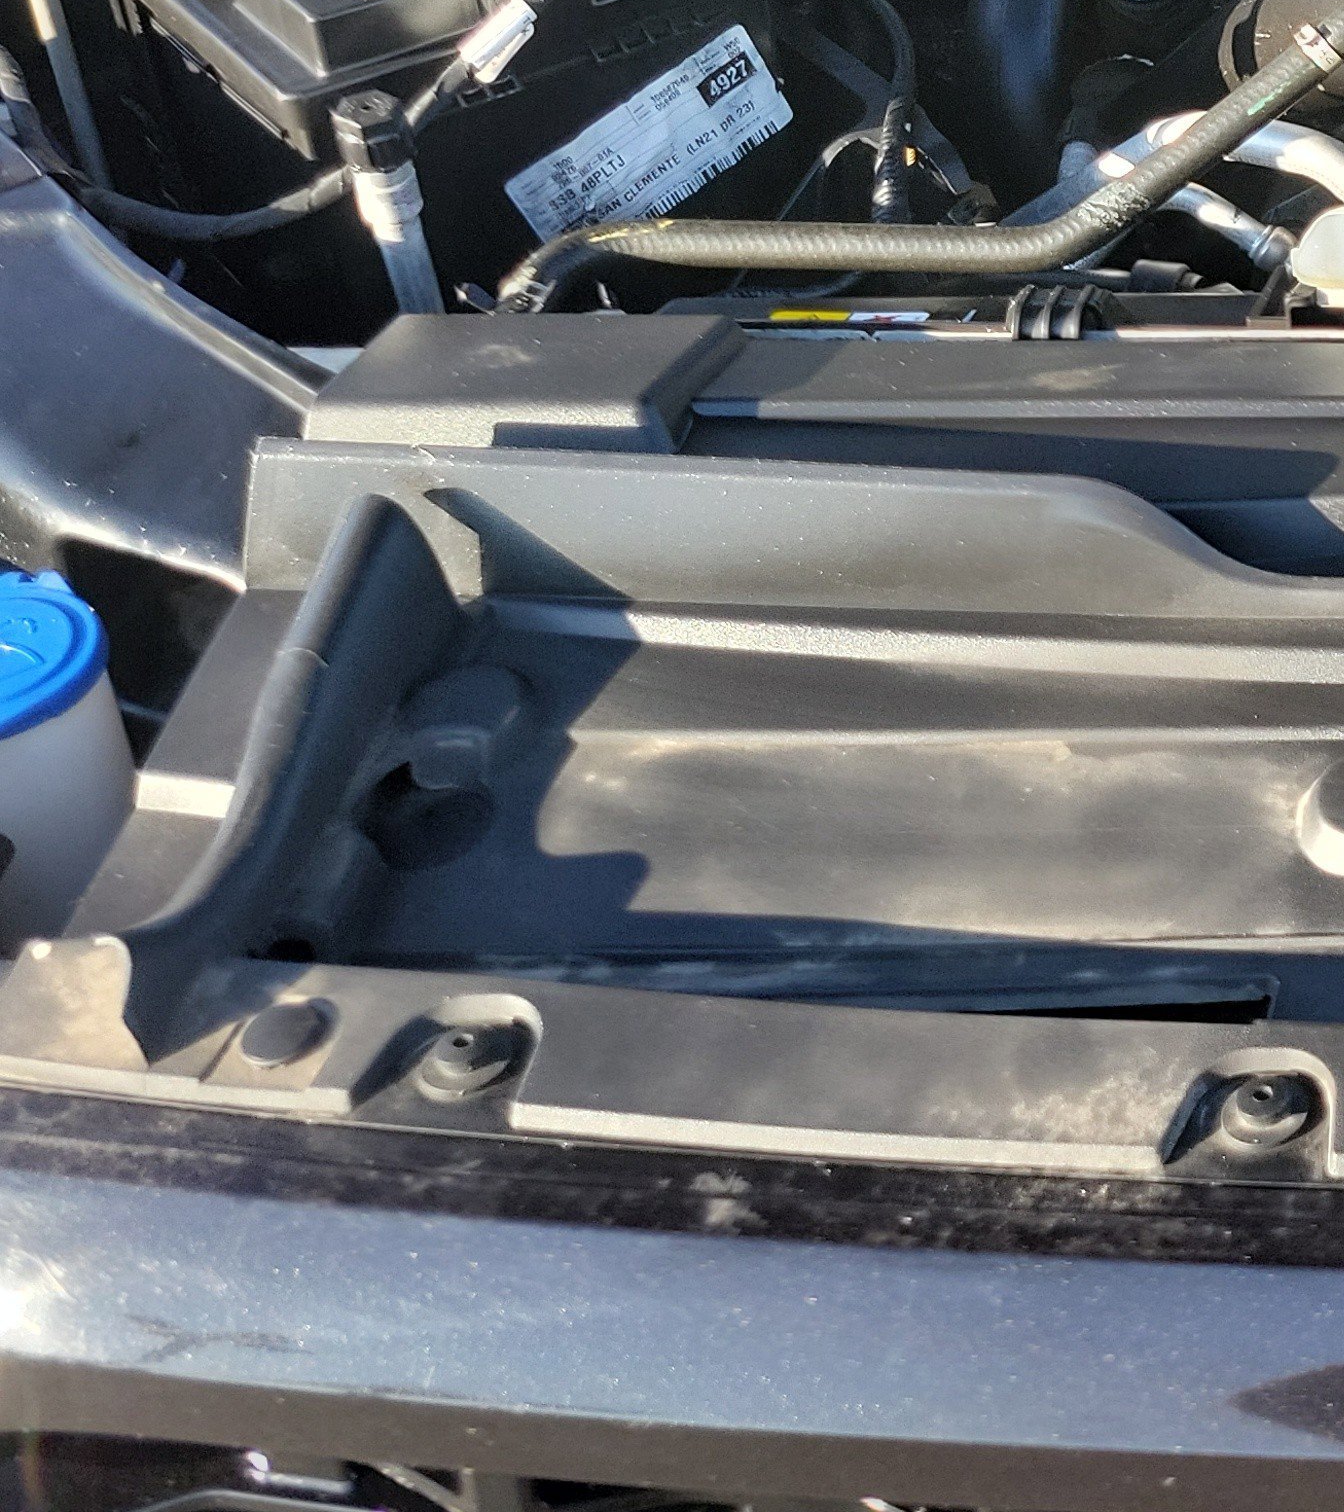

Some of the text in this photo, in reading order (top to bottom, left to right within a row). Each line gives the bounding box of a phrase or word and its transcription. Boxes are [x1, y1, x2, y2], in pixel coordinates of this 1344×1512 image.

[708, 59, 750, 99] 4927
[580, 155, 627, 195] 48PLTJ
[623, 154, 682, 204] CLEMENTE
